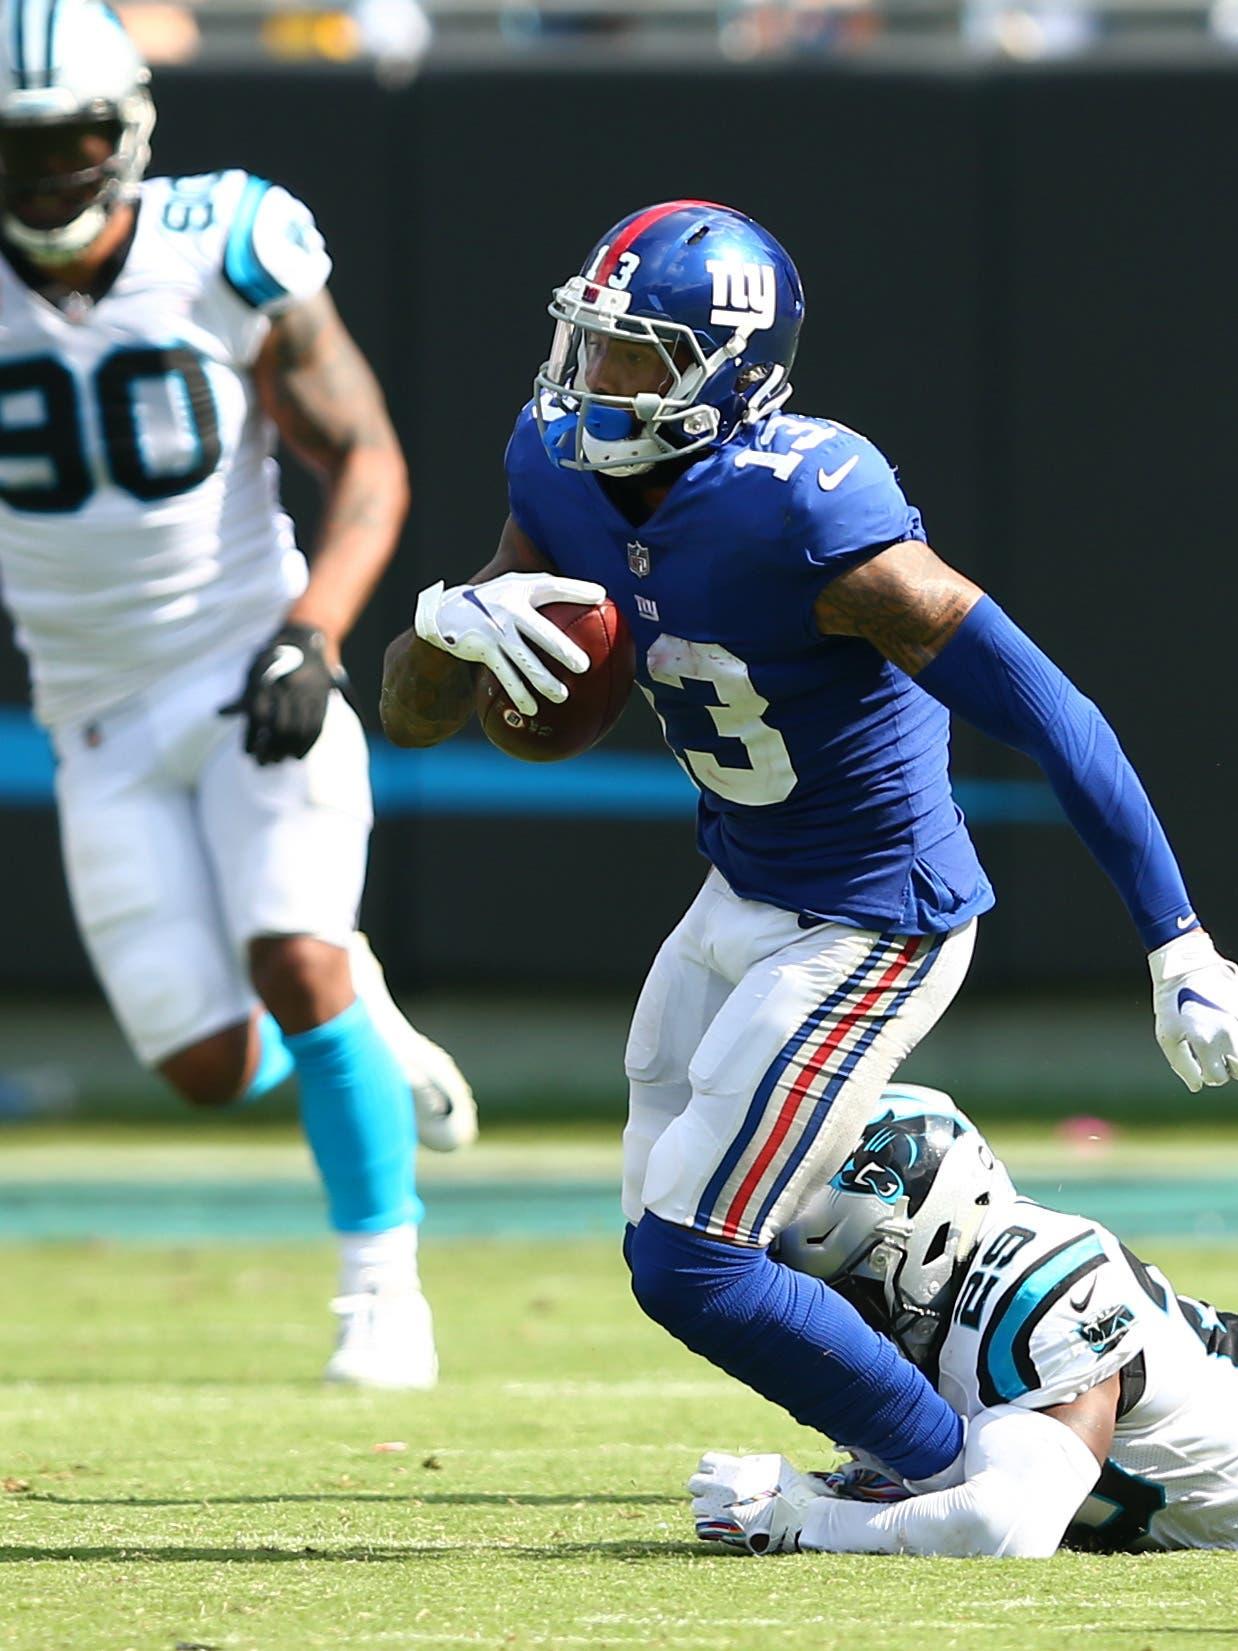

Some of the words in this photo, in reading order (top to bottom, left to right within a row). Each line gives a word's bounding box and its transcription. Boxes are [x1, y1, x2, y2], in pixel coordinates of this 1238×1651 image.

[0, 337, 224, 517] 90
[734, 414, 838, 482] 13
[634, 632, 799, 807] 3
[953, 1225, 1037, 1332] 29
